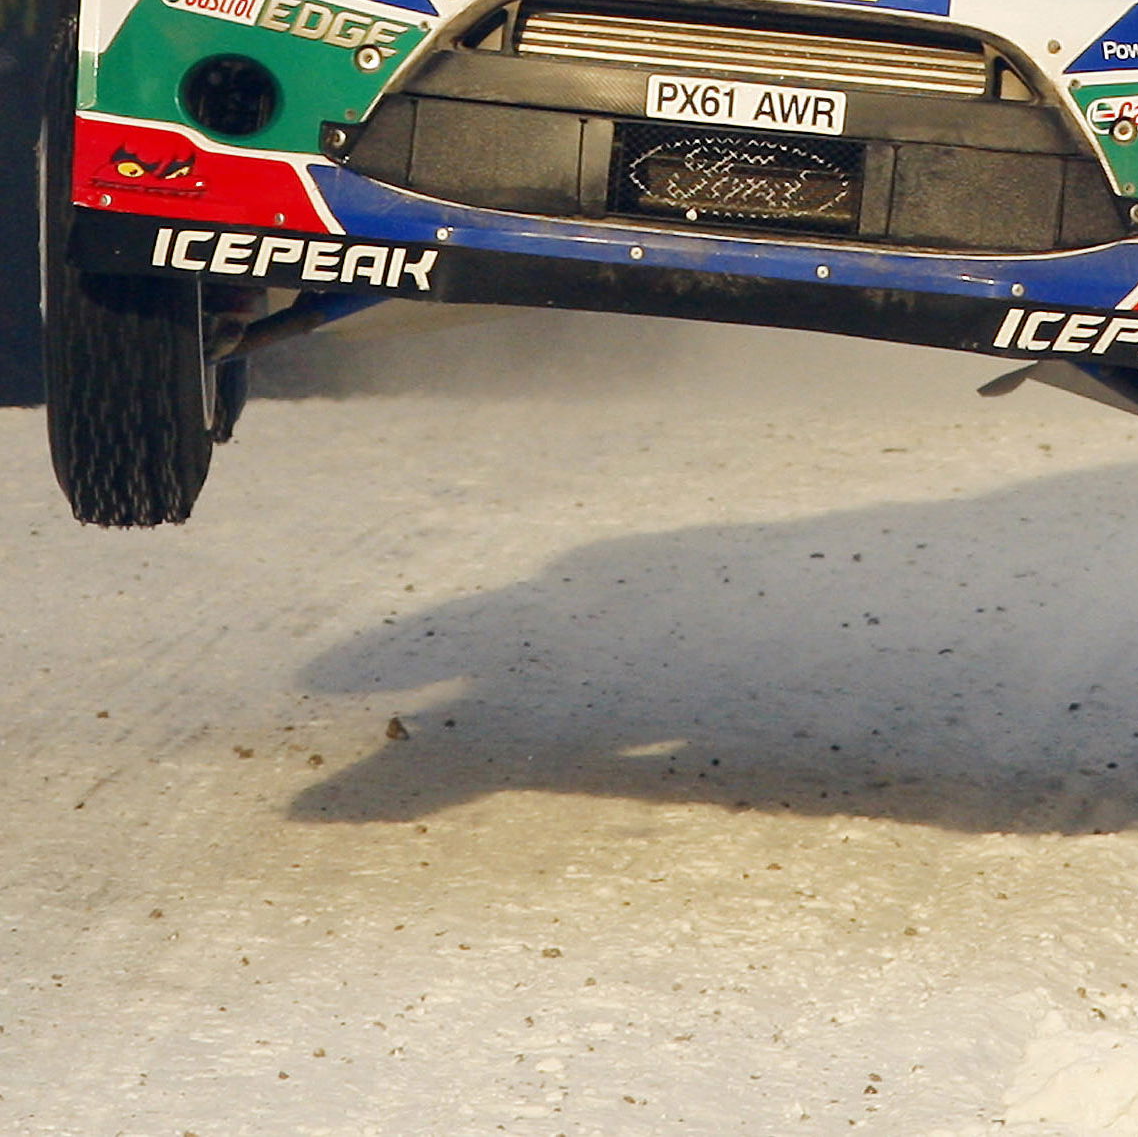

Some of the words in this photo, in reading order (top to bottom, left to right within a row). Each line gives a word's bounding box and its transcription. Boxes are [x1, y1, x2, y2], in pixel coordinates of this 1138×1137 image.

[656, 82, 736, 118] PX61
[753, 92, 836, 128] AWR
[152, 228, 439, 291] ICEPEAK
